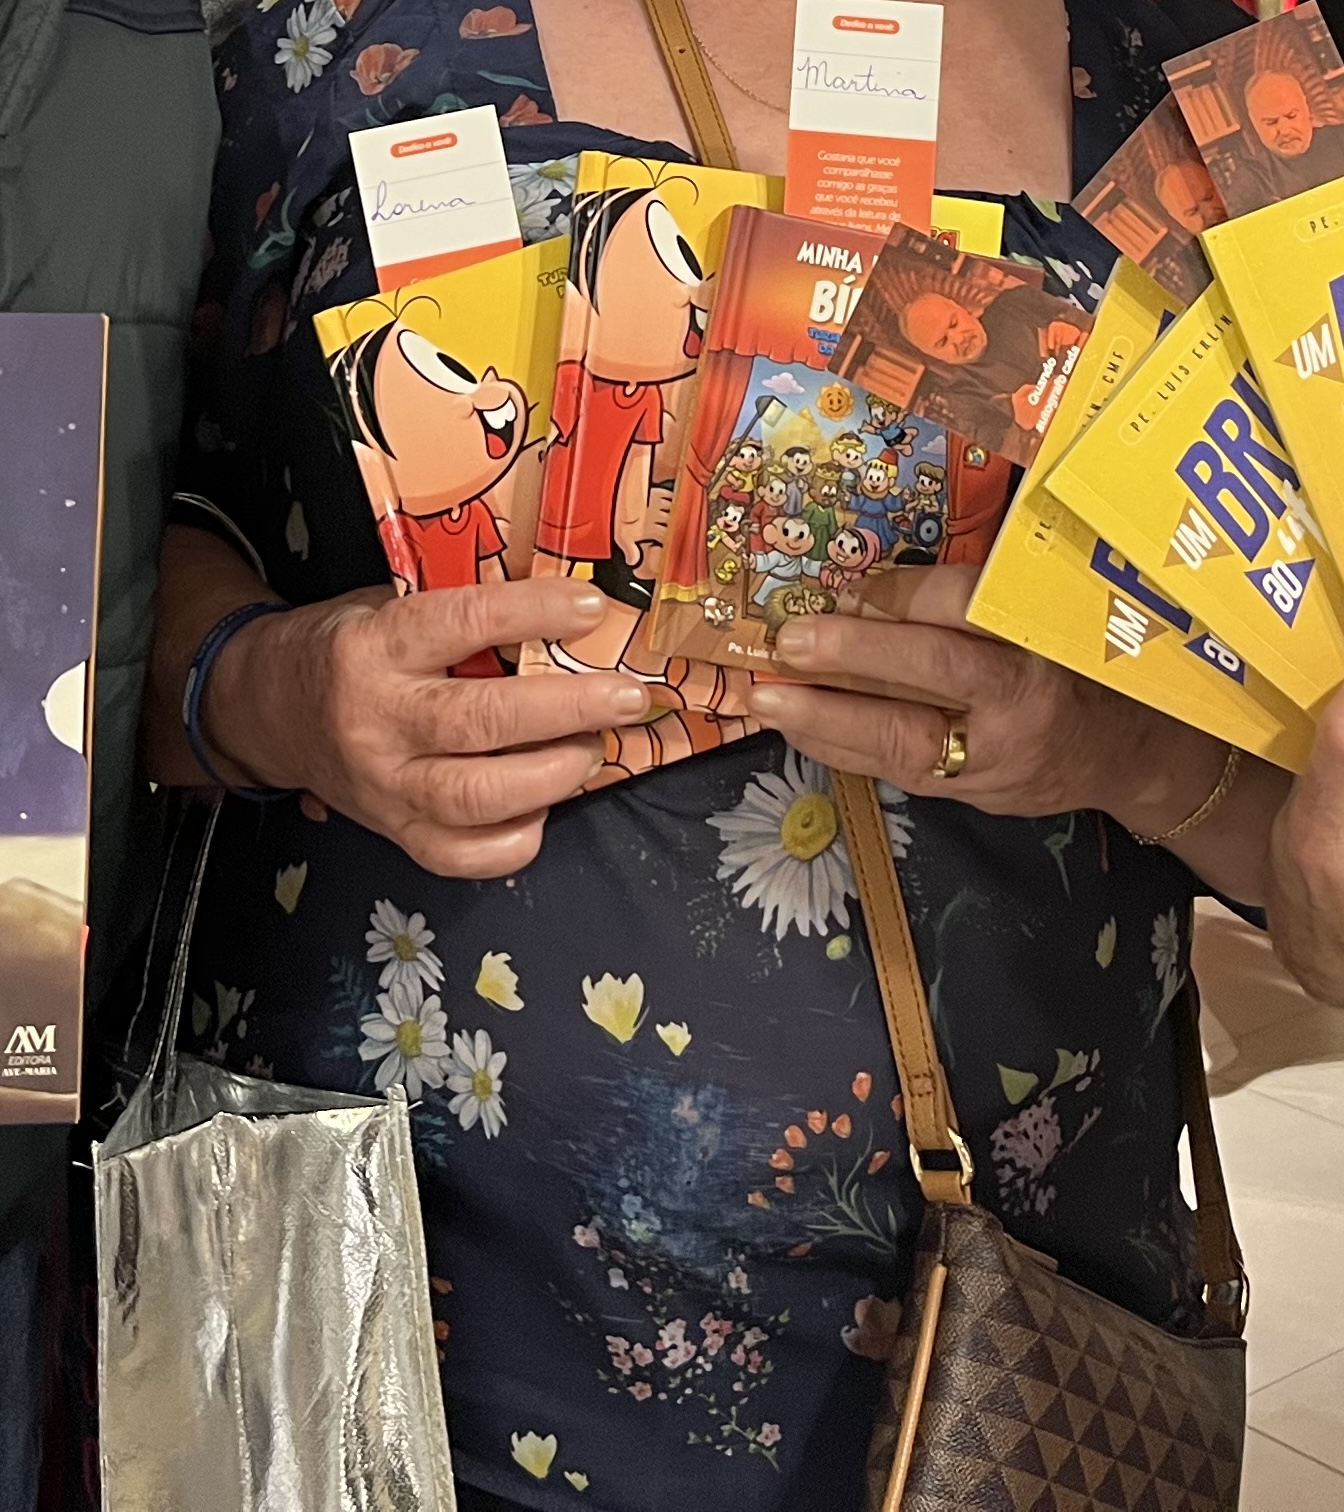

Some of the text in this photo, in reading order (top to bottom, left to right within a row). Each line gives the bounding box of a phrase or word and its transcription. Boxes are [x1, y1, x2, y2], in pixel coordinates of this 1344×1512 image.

[797, 56, 926, 100] Martina
[371, 180, 476, 221] Lorena
[796, 240, 863, 274] MINHA
[1061, 345, 1080, 375] cada
[1291, 322, 1336, 380] UM
[1027, 357, 1057, 405] Quando
[1175, 358, 1301, 563] BRI
[1169, 508, 1218, 570] UM
[1262, 559, 1303, 614] ao
[1104, 598, 1150, 658] UM
[1203, 631, 1241, 672] a
[8, 1055, 52, 1066] EDITORA
